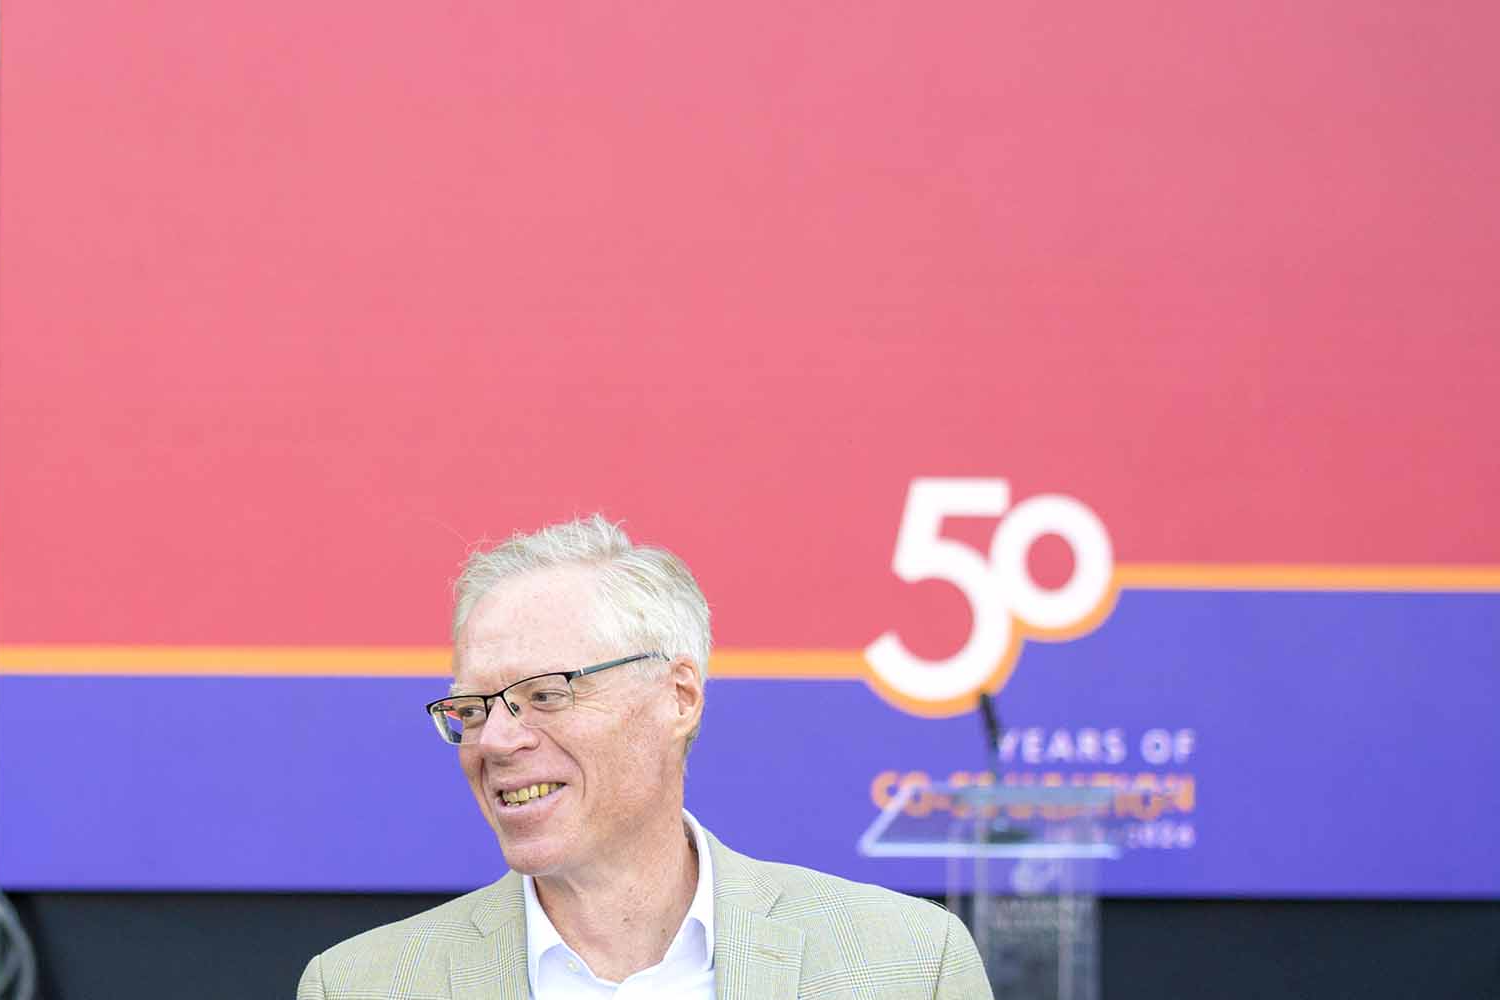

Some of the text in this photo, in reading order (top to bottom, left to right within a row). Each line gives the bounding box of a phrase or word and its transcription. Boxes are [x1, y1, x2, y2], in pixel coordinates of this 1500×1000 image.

[863, 476, 1114, 702] 50
[997, 727, 1197, 765] YEARS OF
